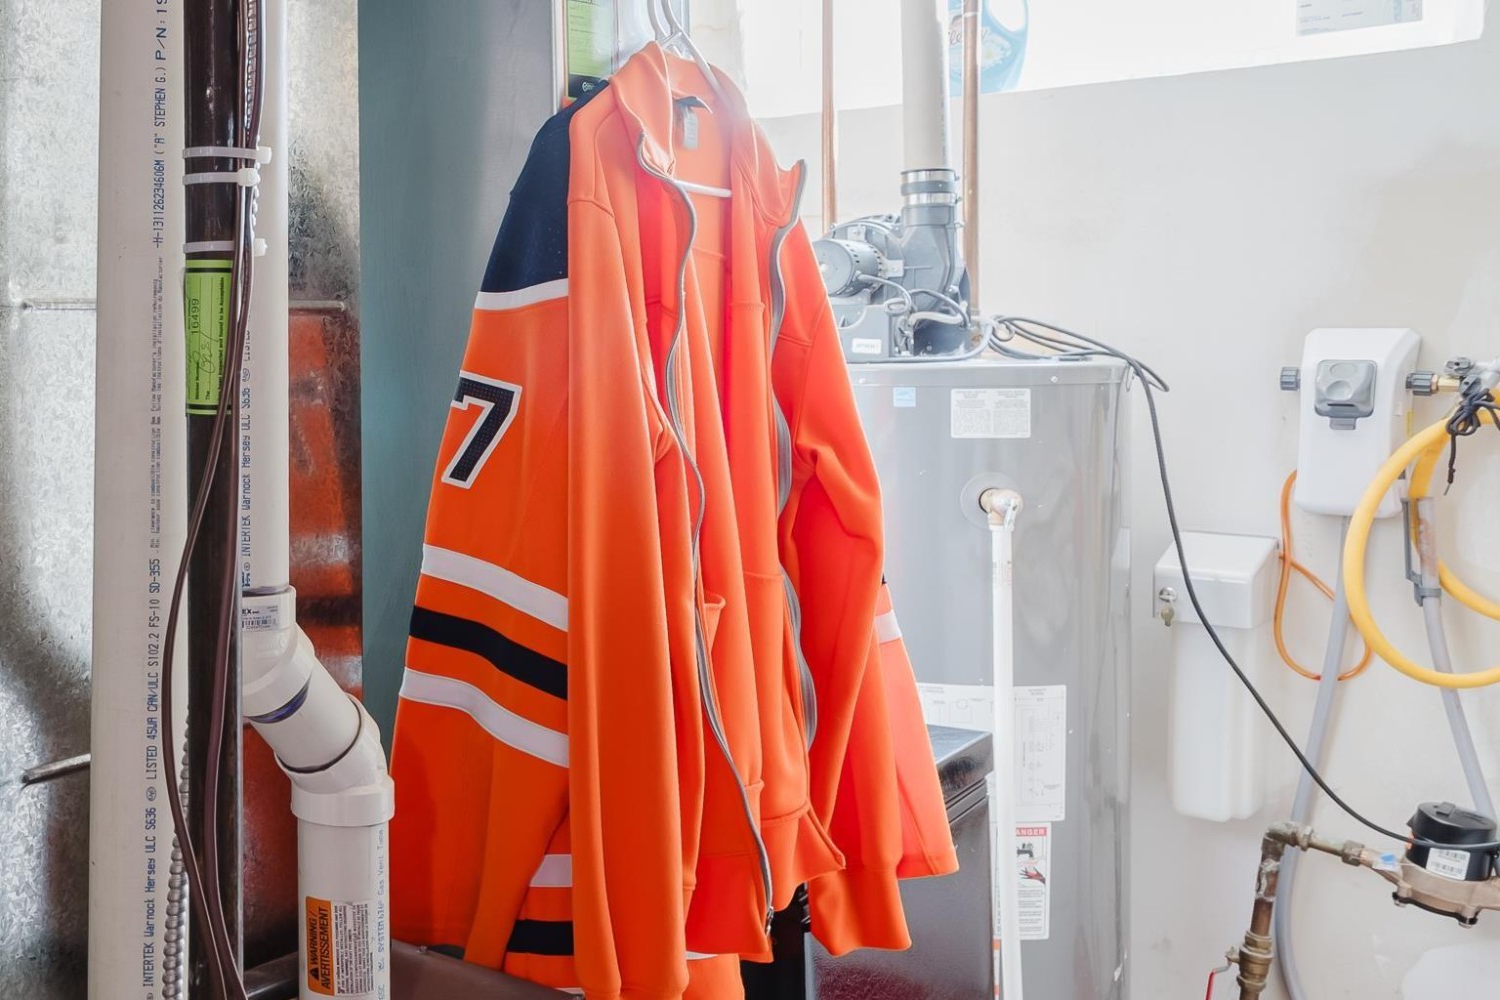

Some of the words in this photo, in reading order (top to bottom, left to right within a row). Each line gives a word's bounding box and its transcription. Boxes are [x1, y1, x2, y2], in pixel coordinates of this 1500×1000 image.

[154, 88, 165, 127] STEPHEN
[191, 298, 200, 335] 16499
[149, 559, 160, 593] SD-355
[149, 599, 159, 627] FS-10
[148, 633, 159, 666] S102.2
[146, 746, 157, 779] LISTED
[145, 807, 156, 830] S636
[1015, 828, 1046, 836] ANGER
[145, 836, 156, 853] ULC
[145, 858, 155, 892] Hersey
[144, 899, 155, 937] Warnock
[309, 919, 317, 965] WARNING
[318, 907, 331, 990] AVERTISSEMENT
[143, 942, 154, 987] INTERTEK
